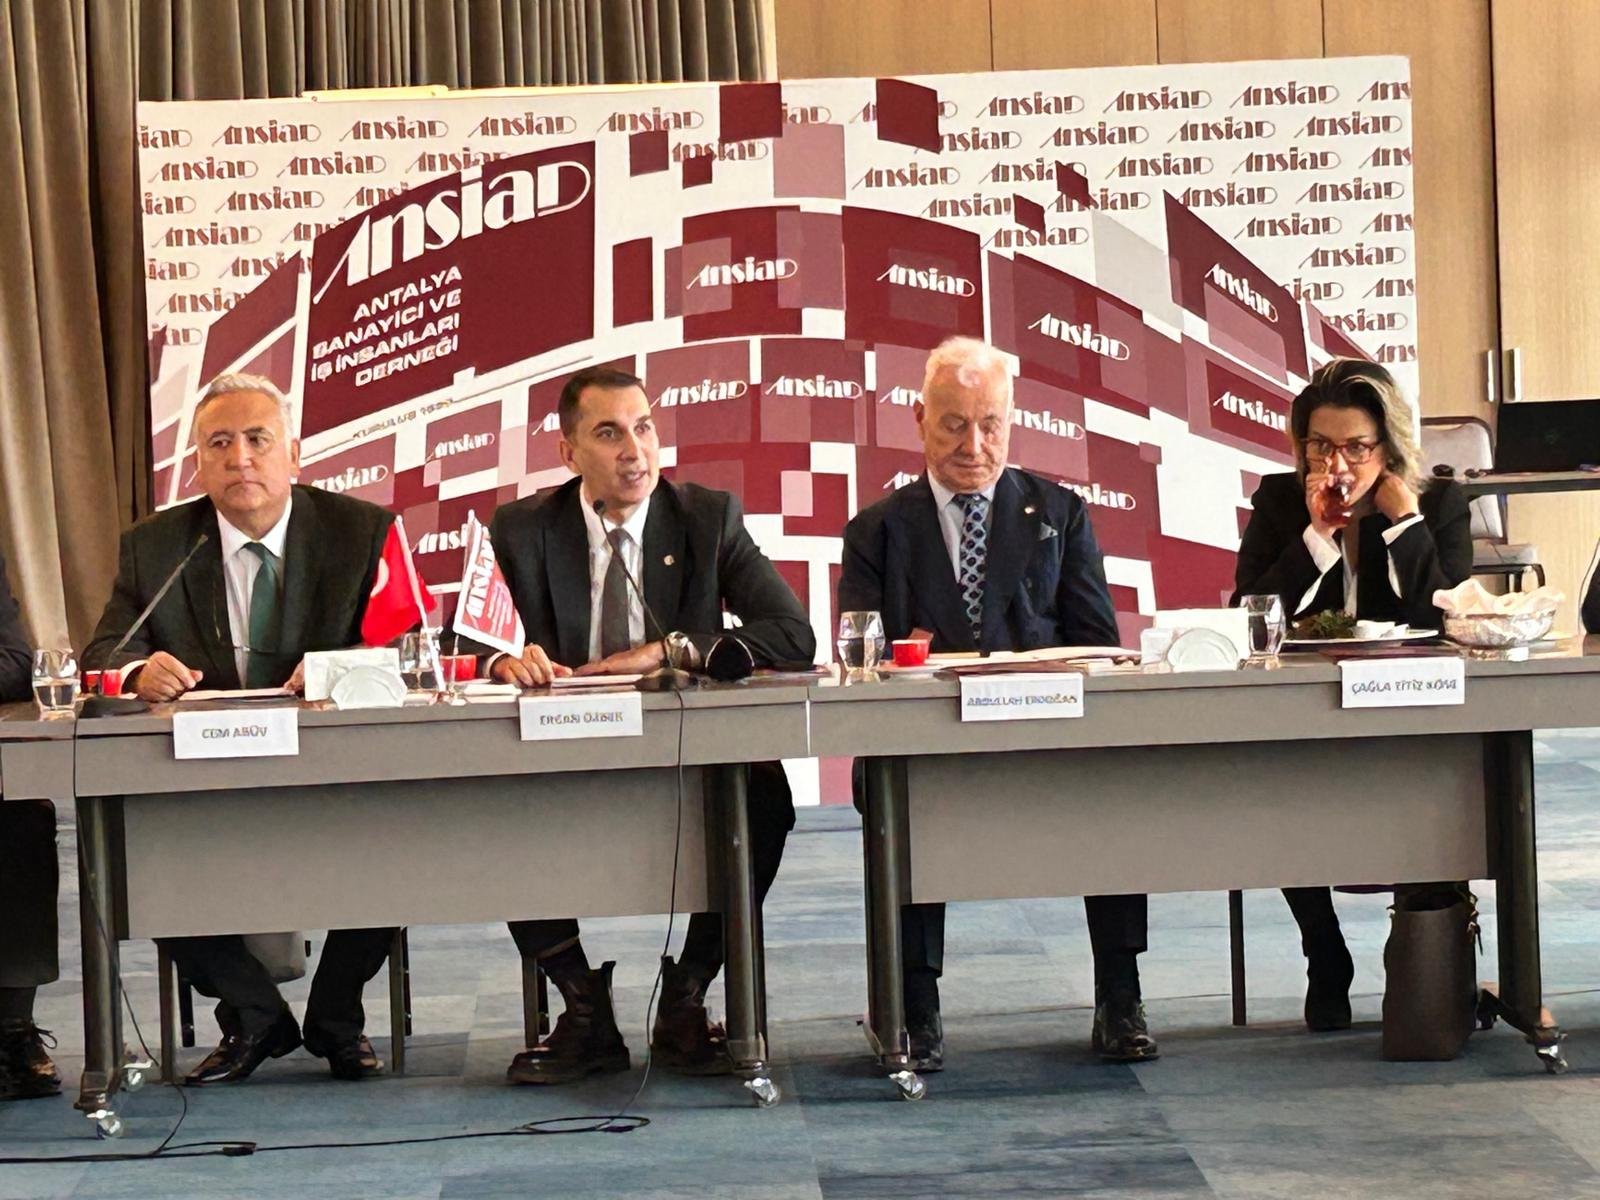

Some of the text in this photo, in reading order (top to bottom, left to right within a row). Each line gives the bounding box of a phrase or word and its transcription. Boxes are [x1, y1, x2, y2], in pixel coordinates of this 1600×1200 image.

[138, 125, 193, 149] iaD
[938, 126, 1023, 152] nsiaD
[143, 191, 197, 215] iaD
[312, 161, 592, 305] AnsiaD
[353, 265, 463, 323] ANTALYA
[429, 288, 462, 314] VE
[1011, 408, 1086, 441] nsiaD
